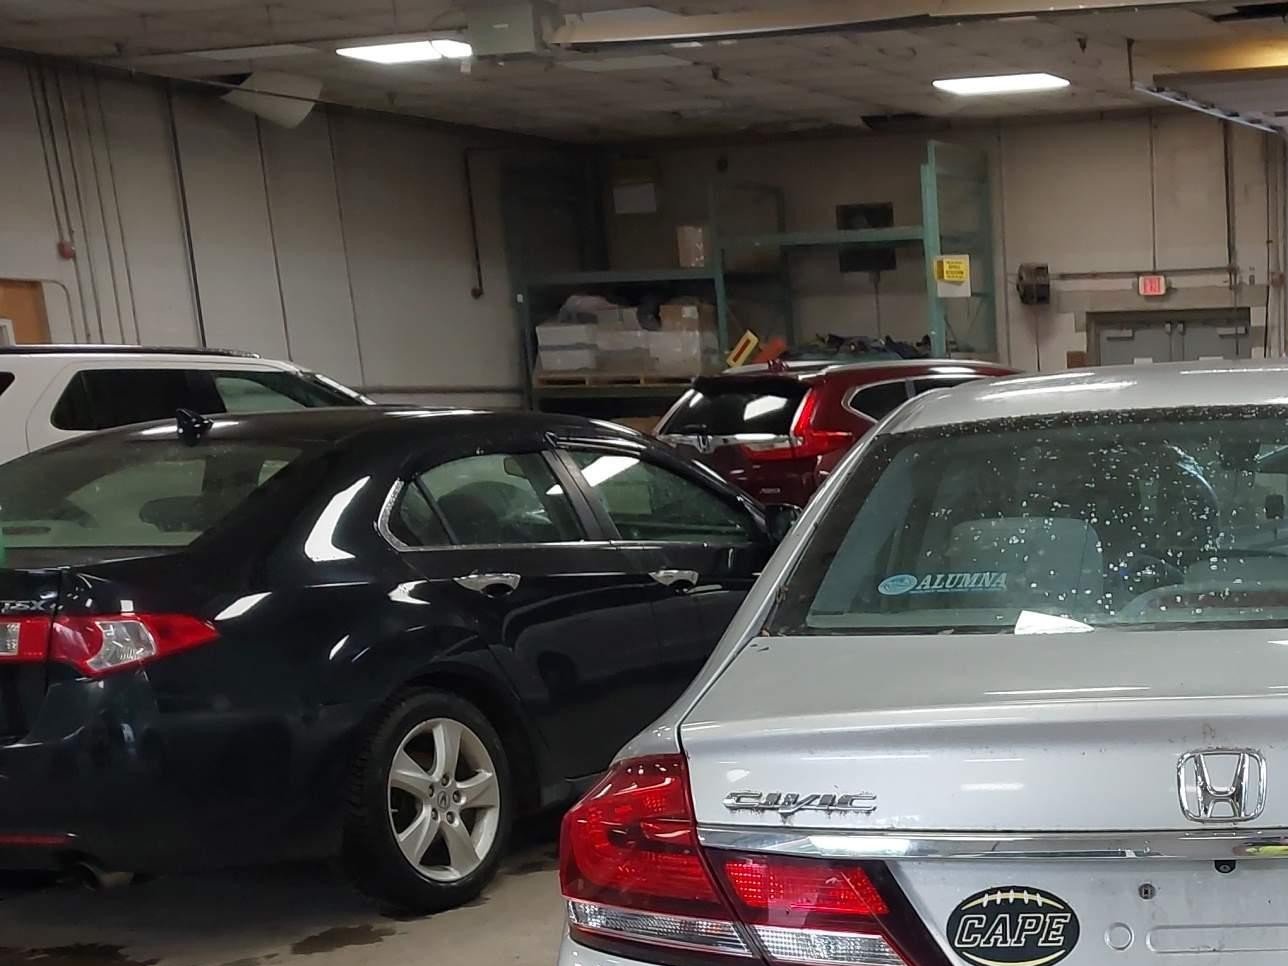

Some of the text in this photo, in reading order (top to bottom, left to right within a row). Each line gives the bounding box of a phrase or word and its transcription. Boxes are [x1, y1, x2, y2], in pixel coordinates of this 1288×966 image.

[915, 572, 1008, 590] ALUMNA
[722, 791, 878, 814] CIVIC
[954, 913, 1072, 948] CAPE
